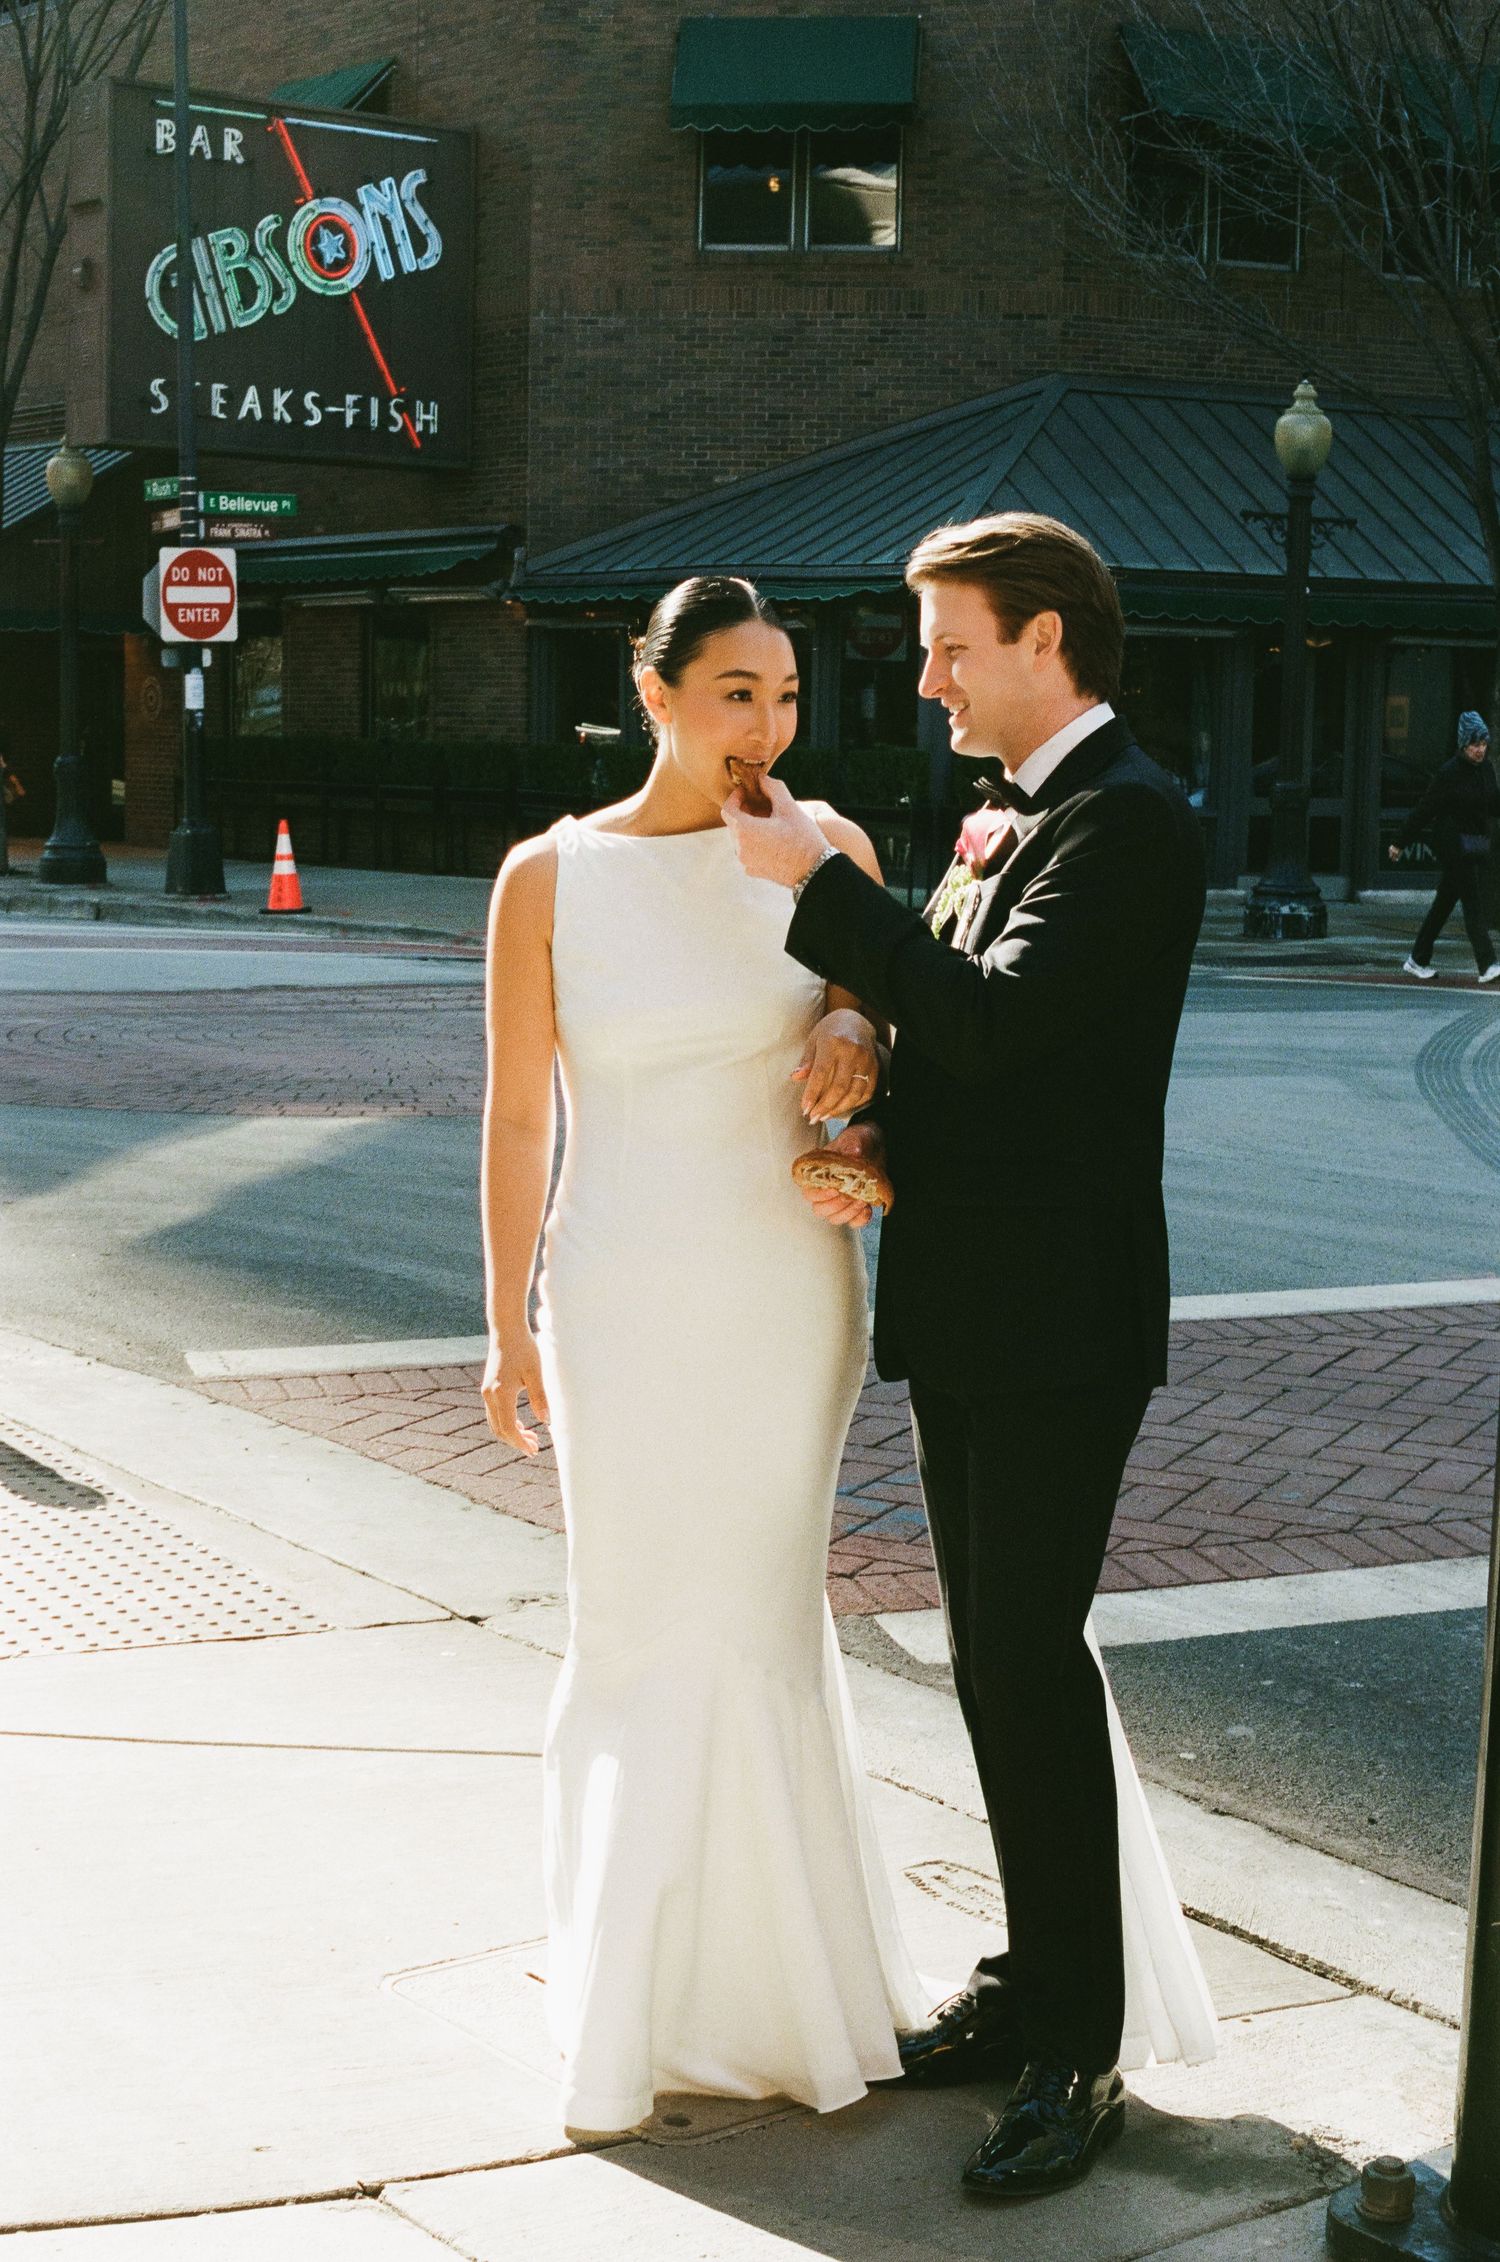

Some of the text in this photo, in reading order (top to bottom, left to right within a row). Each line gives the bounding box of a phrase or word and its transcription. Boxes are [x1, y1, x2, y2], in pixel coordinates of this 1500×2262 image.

[155, 118, 245, 164] BAR
[149, 378, 439, 435] SEAKS-FISH
[209, 498, 216, 508] E
[218, 495, 279, 512] Bellevue
[209, 527, 232, 538] FRANK
[233, 527, 262, 539] SINATRA
[171, 566, 225, 582] DO NOT
[177, 607, 221, 623] ENTER
